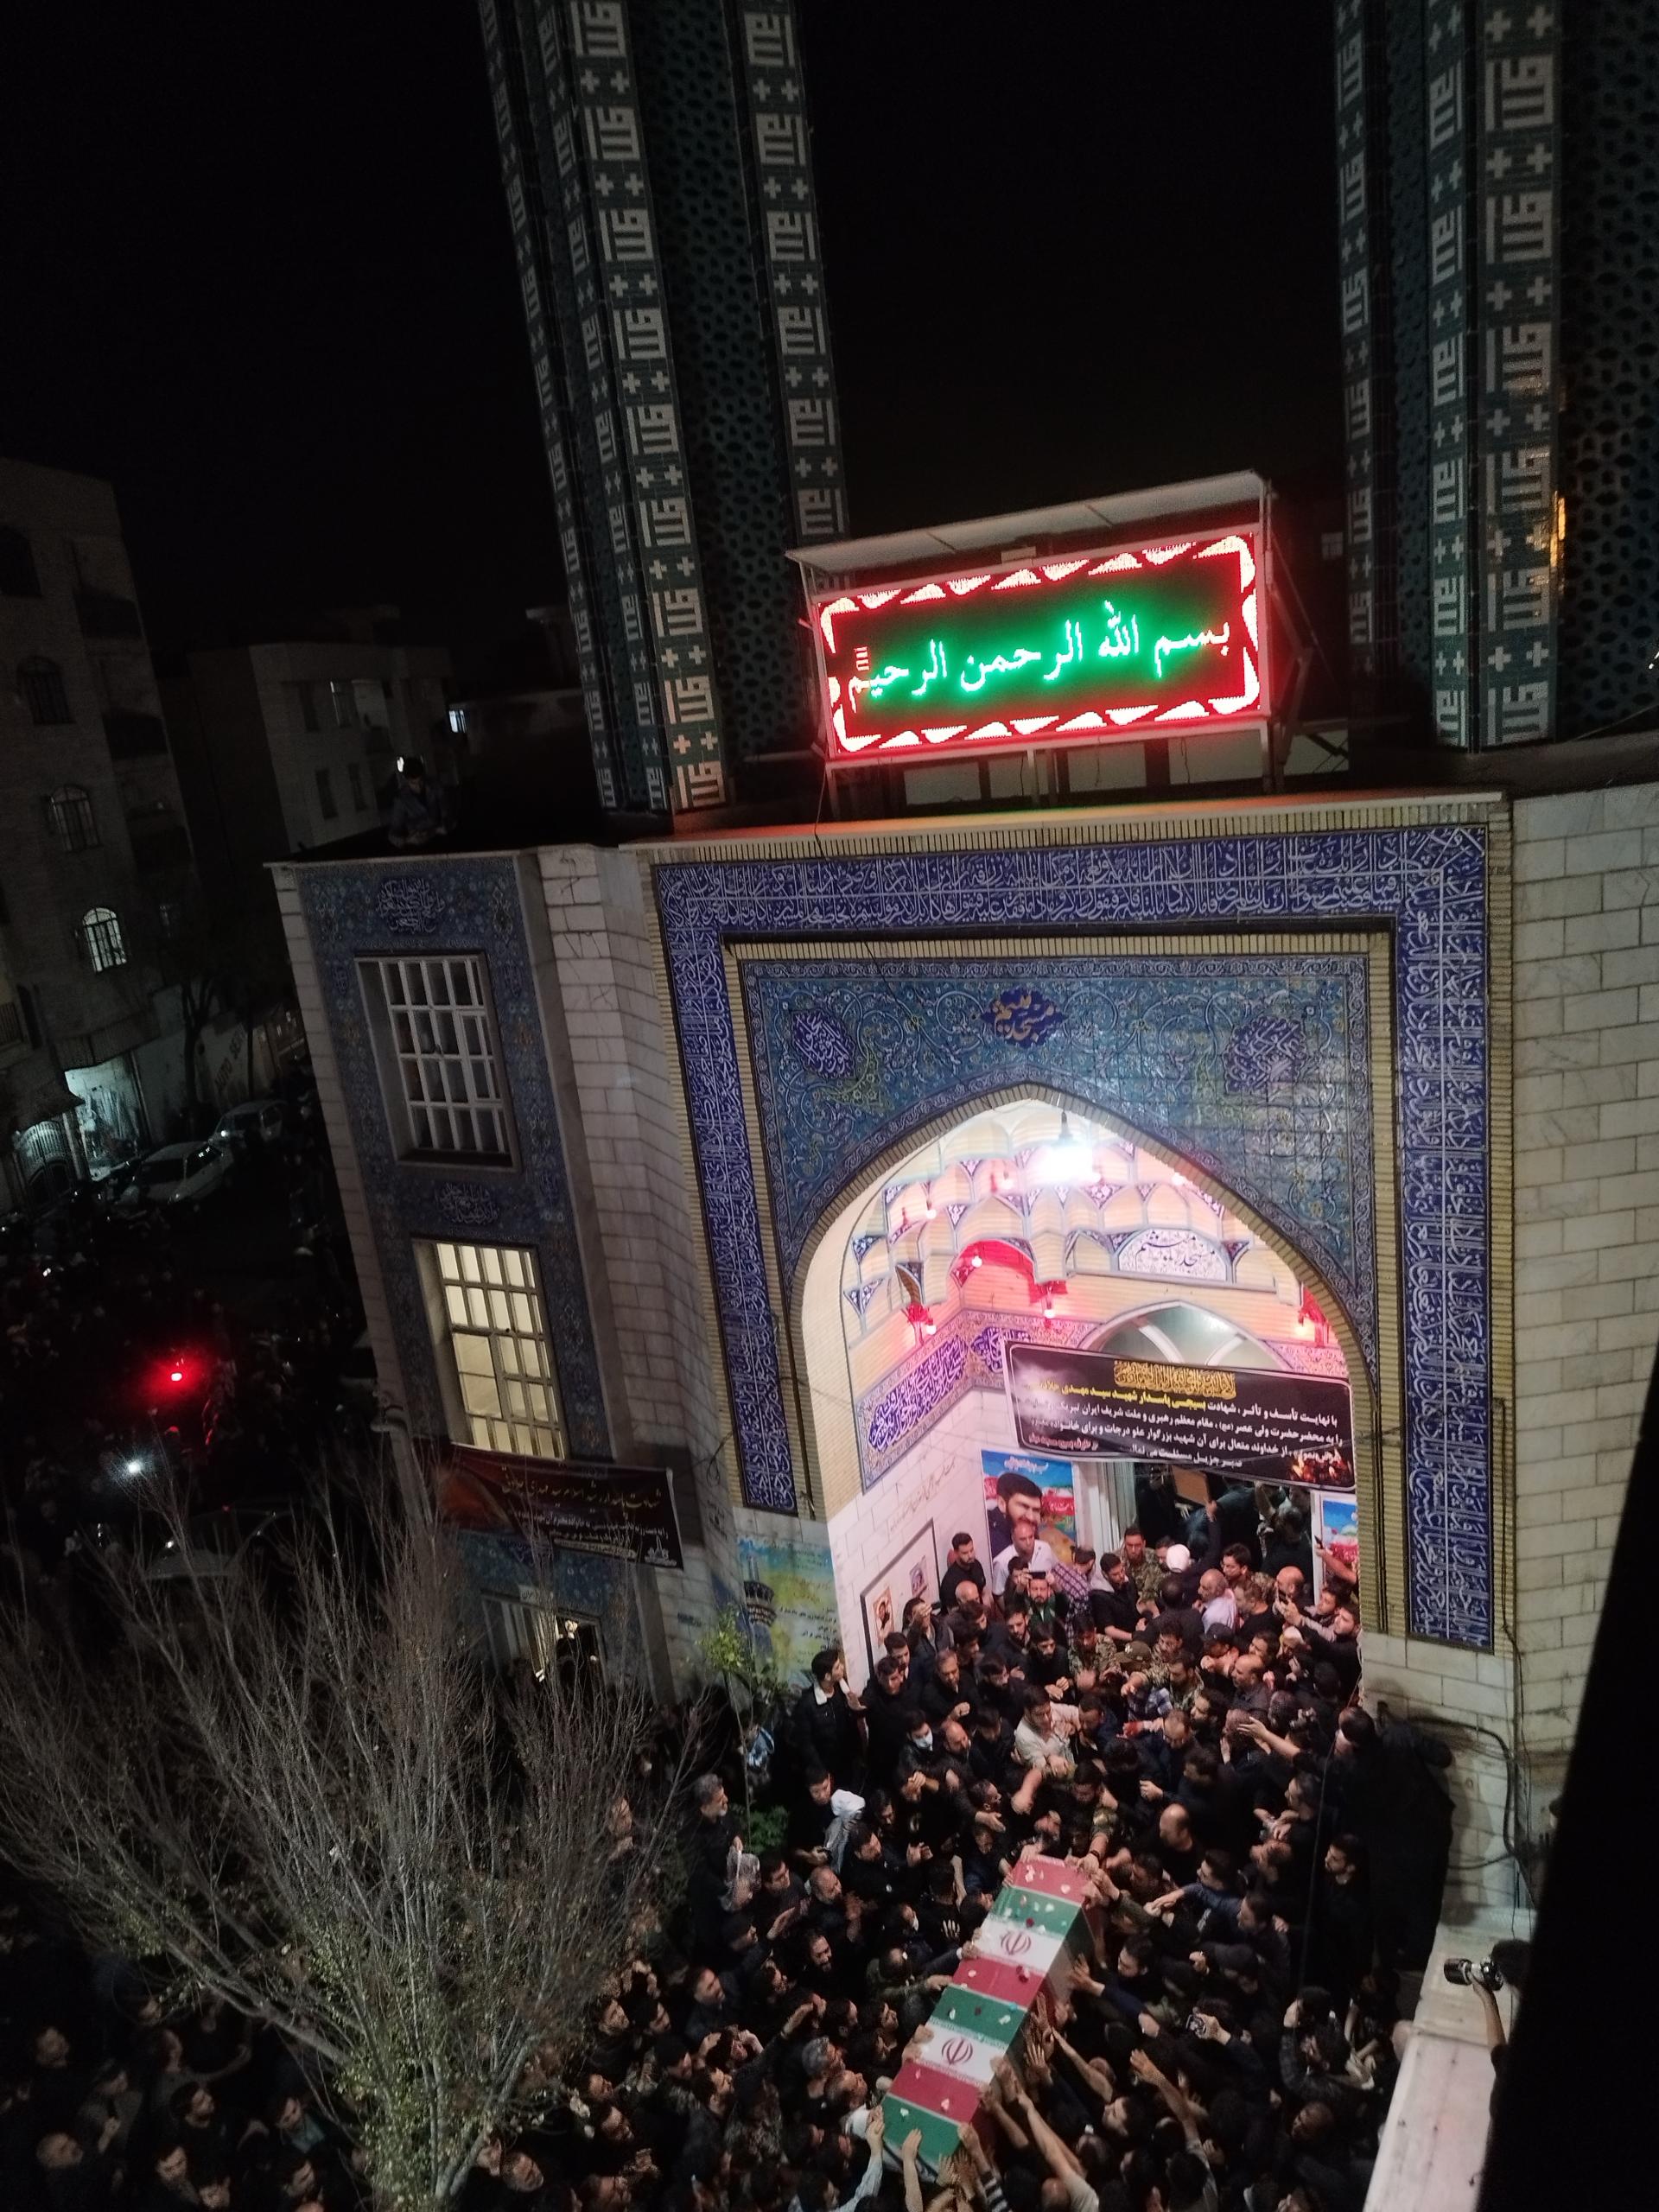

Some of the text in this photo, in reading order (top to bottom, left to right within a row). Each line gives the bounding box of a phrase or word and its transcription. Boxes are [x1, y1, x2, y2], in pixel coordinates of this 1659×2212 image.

[1098, 601, 1139, 659] الله
[959, 620, 1084, 692] الرحمن
[1154, 621, 1230, 678] بسم
[1090, 1387, 1111, 1399] سید
[1082, 1402, 1100, 1415] ایران
[1101, 1405, 1123, 1419] شریف
[1125, 1408, 1141, 1419] ملت
[1143, 1413, 1147, 1421] و
[1148, 1414, 1173, 1426] رهبری
[1174, 1414, 1195, 1426] معظم
[1197, 1417, 1213, 1429] مقام
[1099, 1425, 1103, 1435] و
[1104, 1423, 1130, 1437] درجات
[1147, 1428, 1172, 1443] بزرگوار
[1255, 1424, 1269, 1438] ولی
[1173, 1433, 1195, 1445] شهید
[1197, 1433, 1206, 1447] آن
[1209, 1436, 1226, 1450] برای
[1228, 1438, 1249, 1451] متعال
[1251, 1442, 1279, 1455] خداوند
